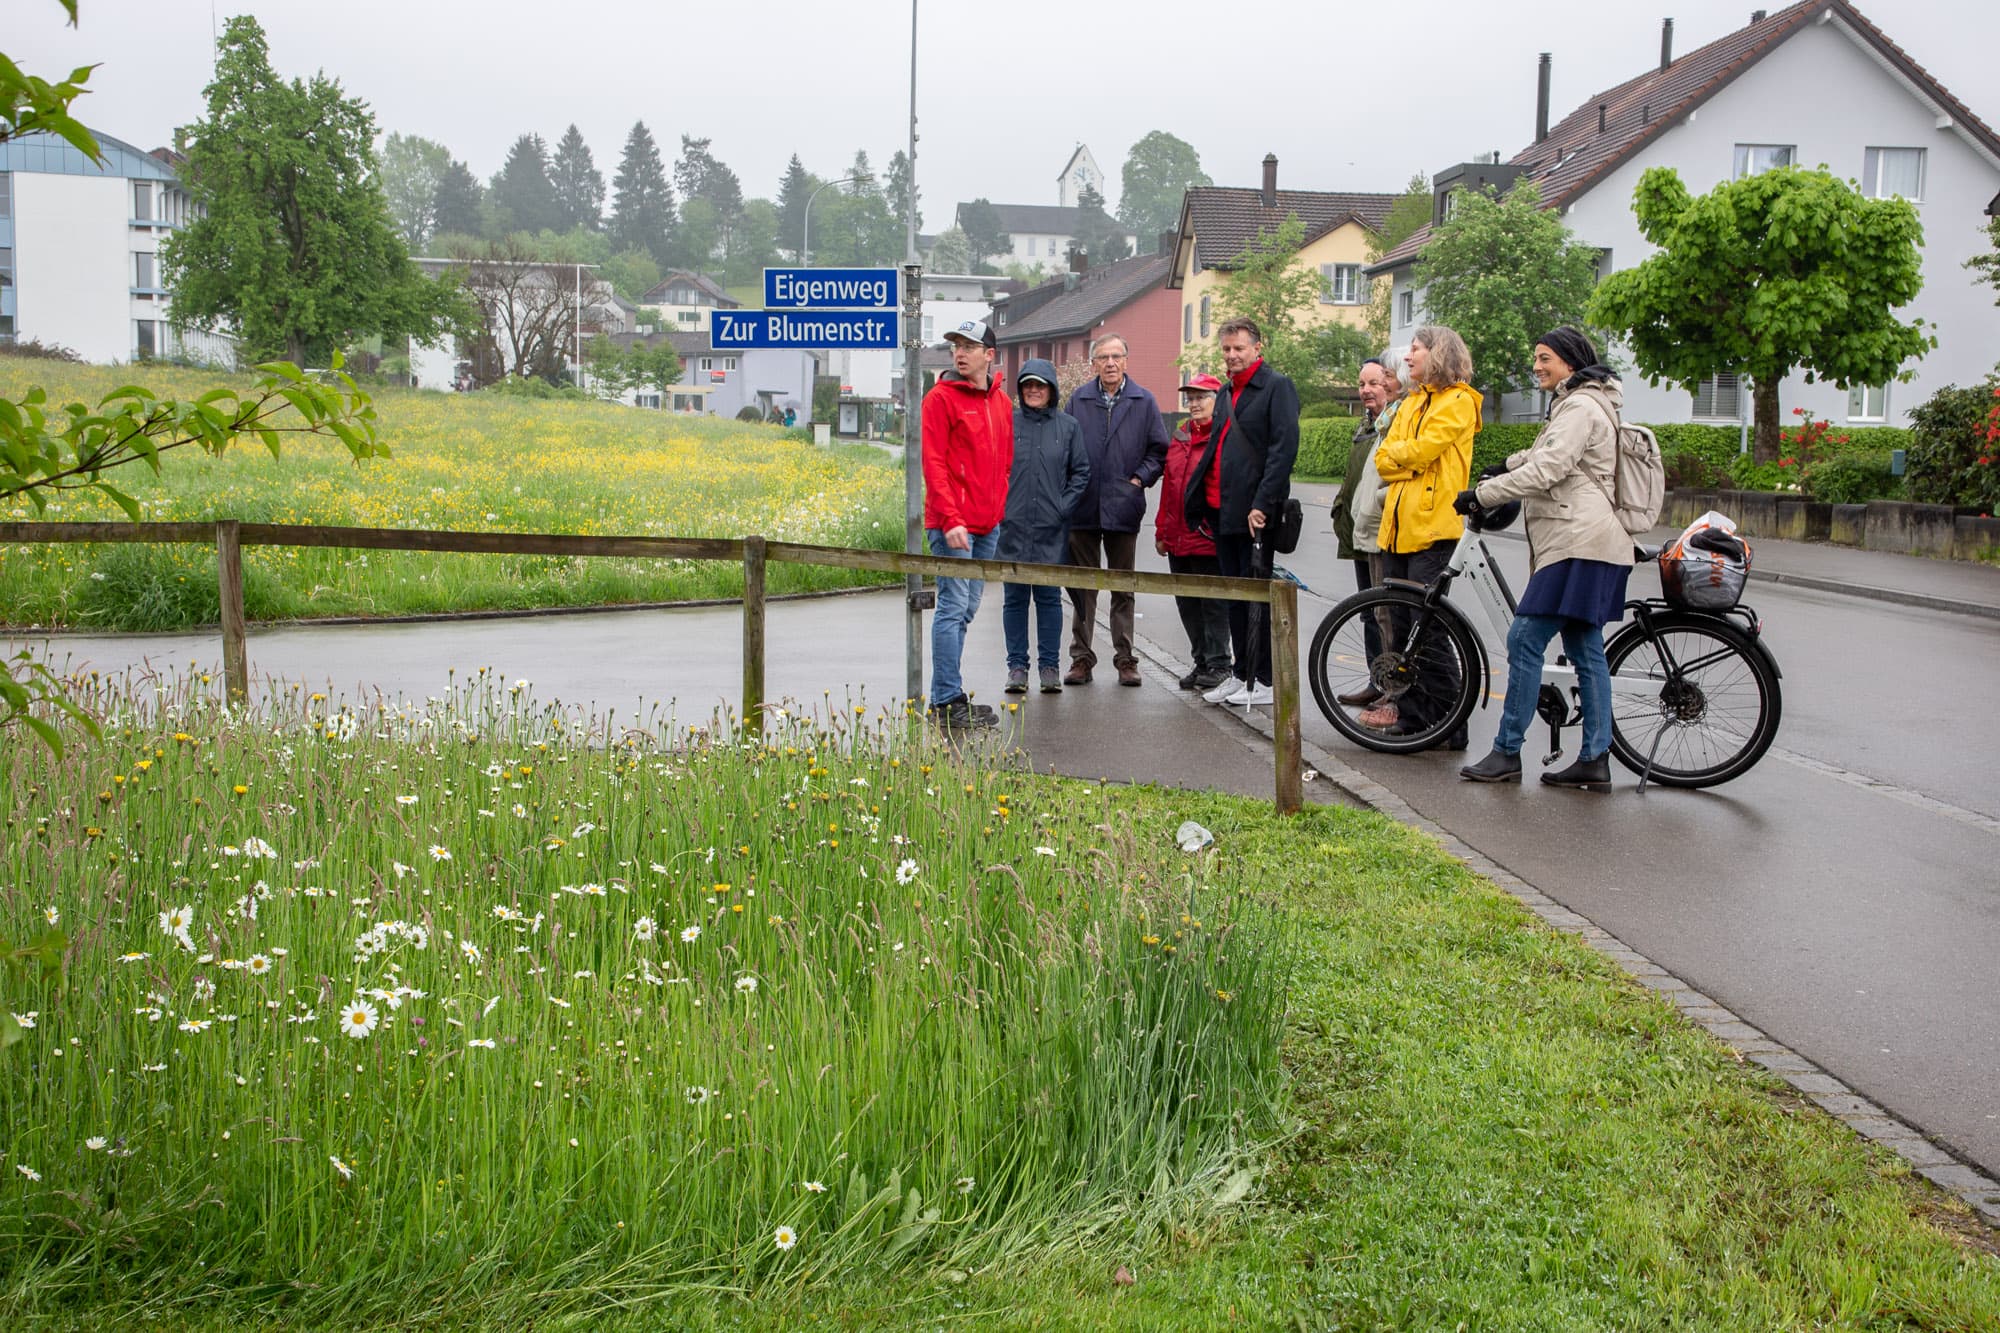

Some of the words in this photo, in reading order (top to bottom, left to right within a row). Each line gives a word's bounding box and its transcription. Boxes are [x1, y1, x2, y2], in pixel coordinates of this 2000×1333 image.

[775, 274, 887, 307] Eigenweg
[719, 316, 757, 341] Zur
[768, 315, 890, 341] Blumenstr.
